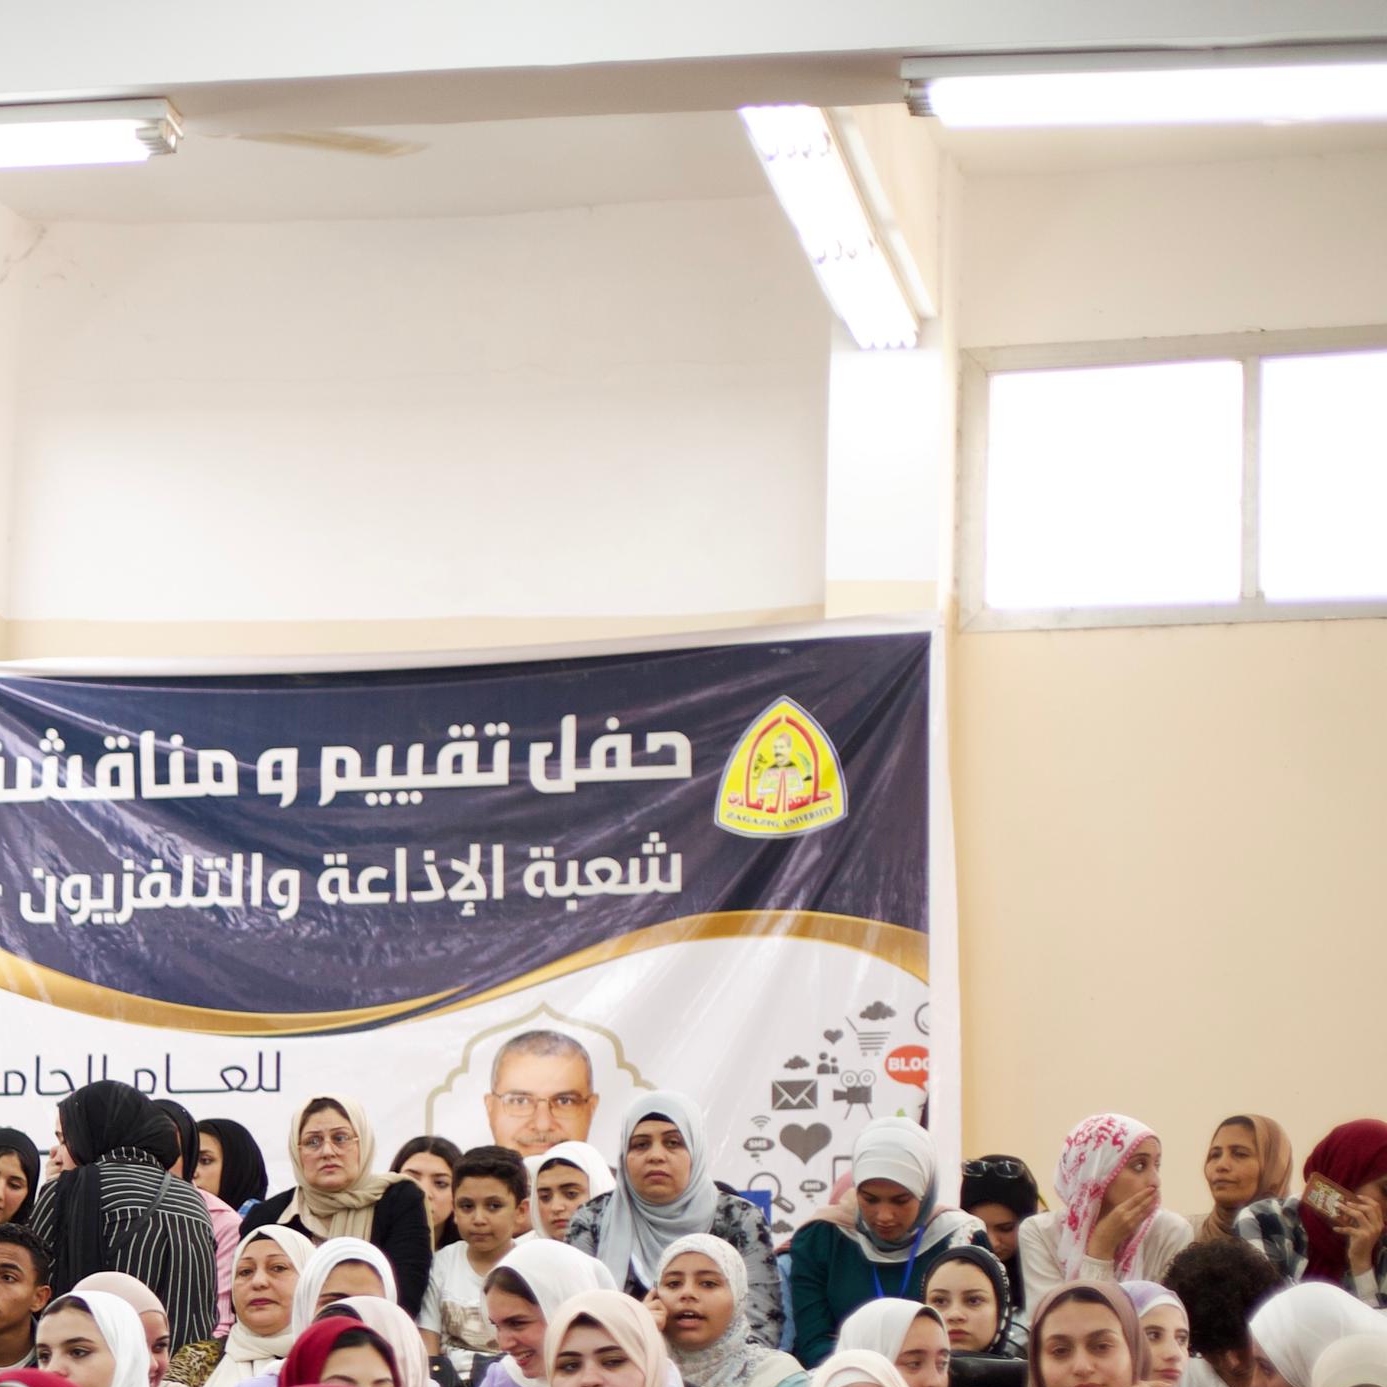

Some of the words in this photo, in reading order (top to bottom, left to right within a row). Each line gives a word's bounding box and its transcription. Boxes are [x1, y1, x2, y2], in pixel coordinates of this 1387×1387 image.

[256, 747, 299, 808] و
[318, 722, 511, 806] تقييم
[529, 714, 692, 794] حفل
[20, 852, 300, 925] والتلفزيون
[317, 843, 504, 916] الإذاعة
[523, 832, 682, 911] شعبة
